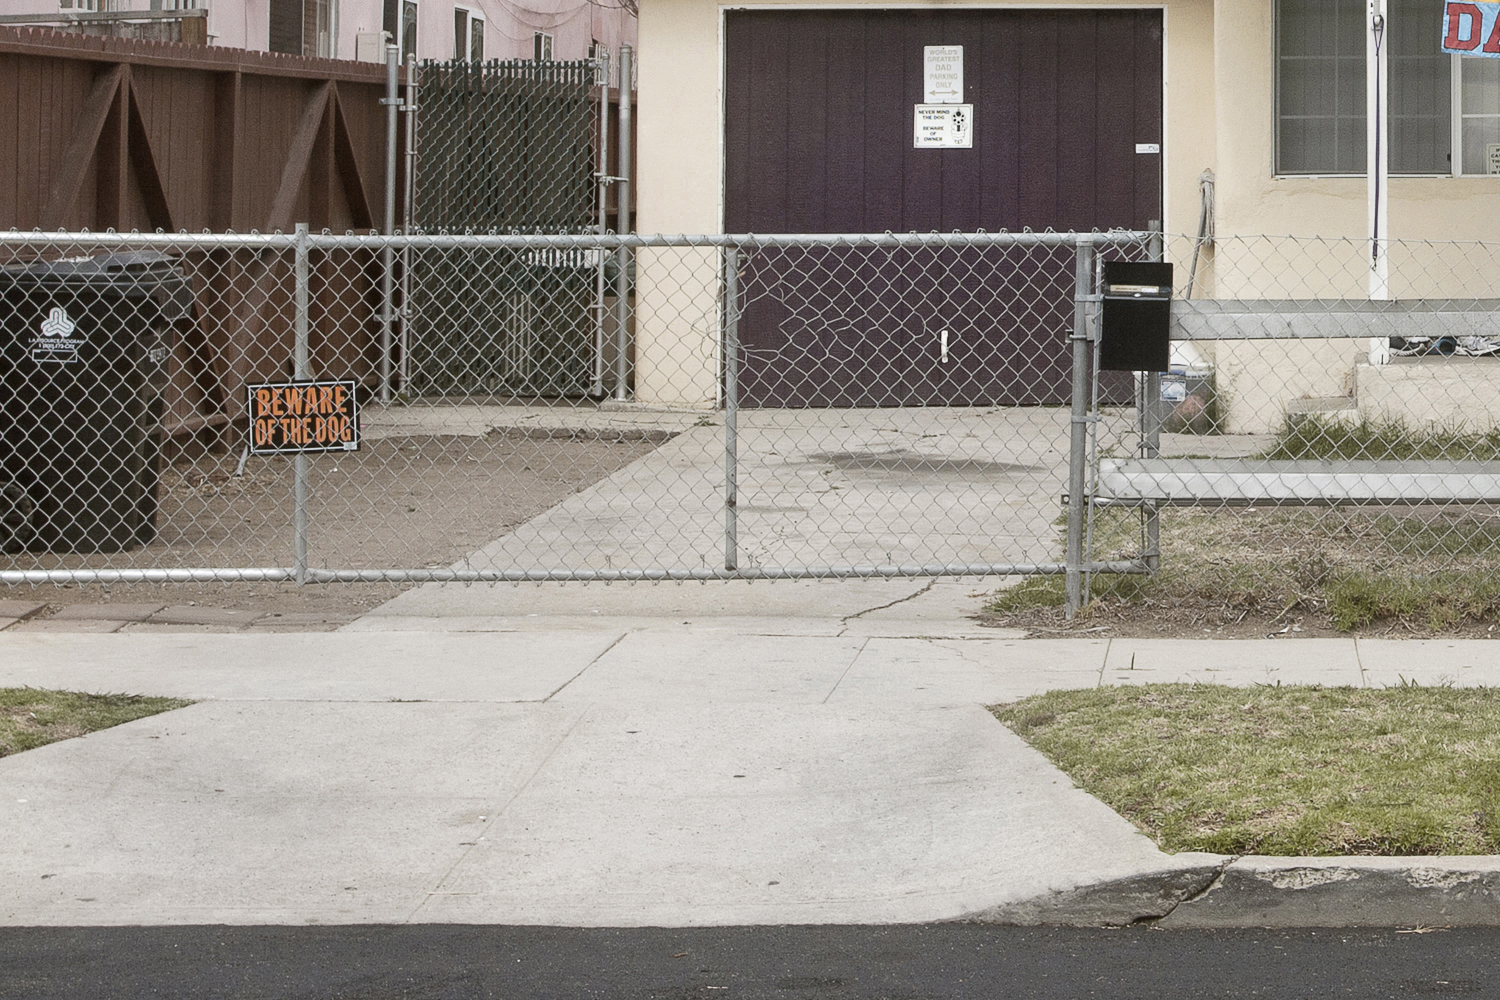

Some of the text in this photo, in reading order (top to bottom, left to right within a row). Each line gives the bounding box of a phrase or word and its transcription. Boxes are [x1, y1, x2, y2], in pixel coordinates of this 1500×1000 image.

[257, 386, 347, 416] BEWARE
[255, 415, 351, 446] OF THE DOG
